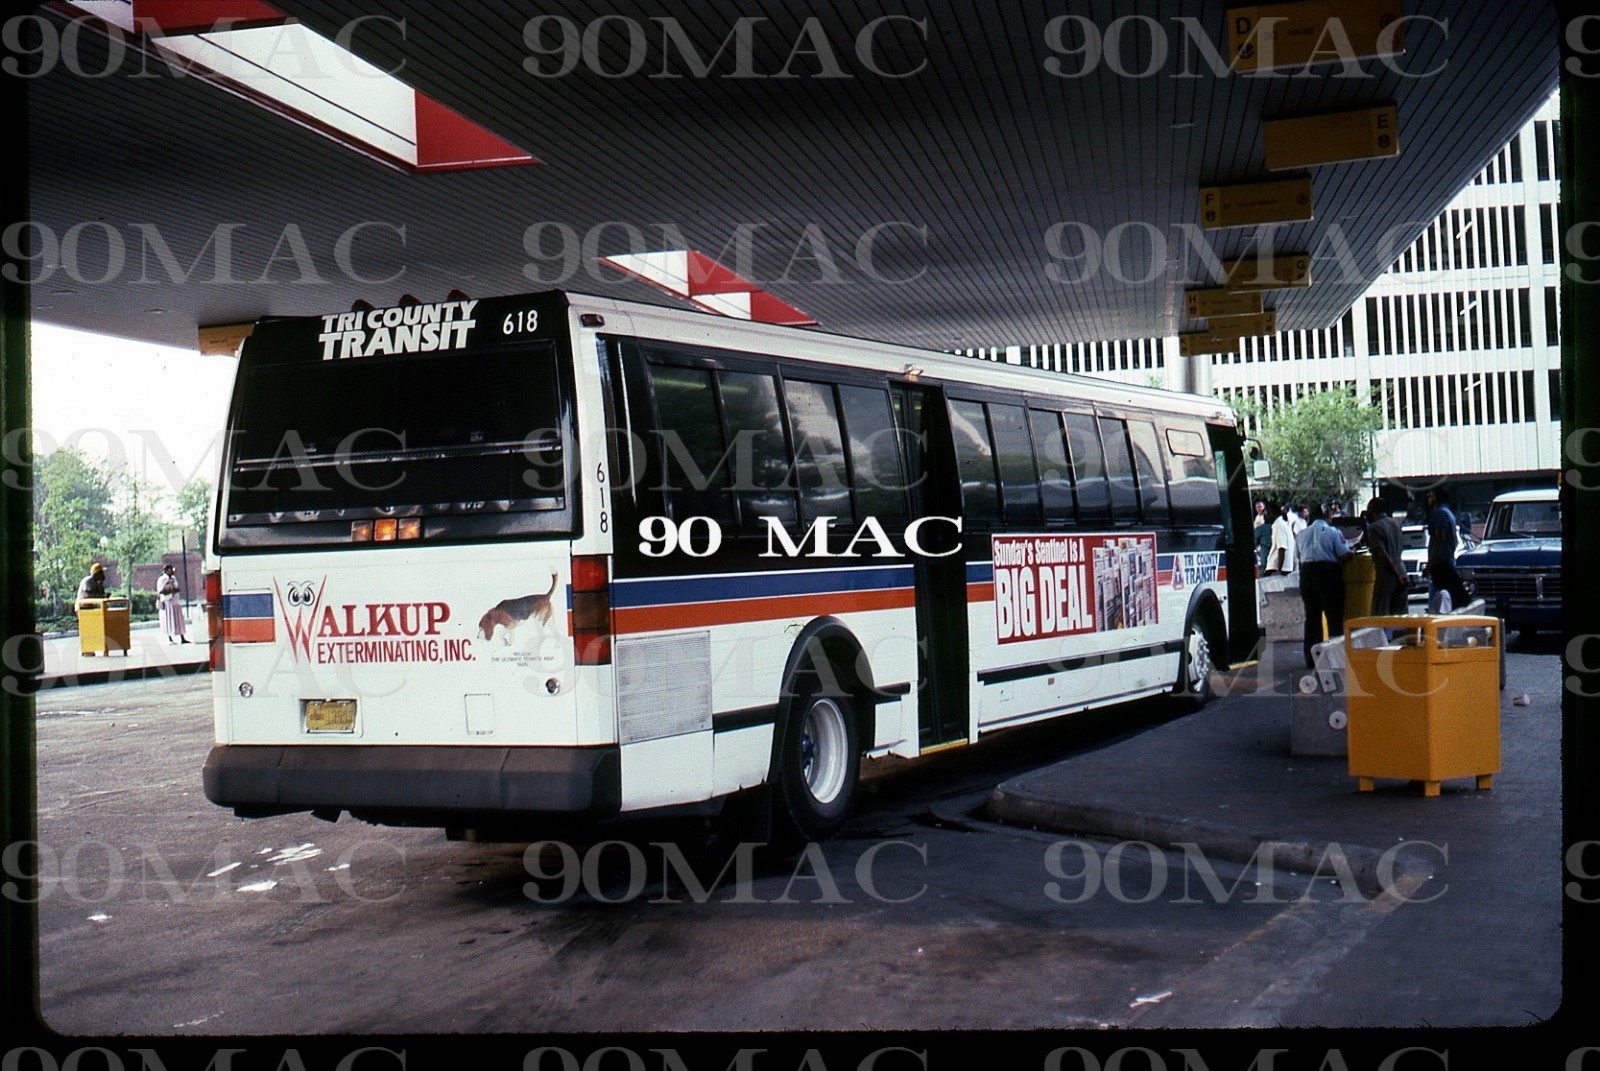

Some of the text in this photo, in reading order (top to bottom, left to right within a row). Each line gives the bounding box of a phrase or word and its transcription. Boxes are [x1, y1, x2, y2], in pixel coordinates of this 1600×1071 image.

[1236, 17, 1251, 35] D
[1377, 114, 1389, 129] E
[322, 299, 479, 334] TRI COUNTY
[502, 309, 539, 335] 618
[318, 319, 477, 361] TRANSIT
[994, 539, 1033, 567] Sunday's
[1035, 538, 1067, 564] Sentinel
[1079, 538, 1085, 562] A
[1184, 553, 1218, 567] TRI COUNTY
[1185, 566, 1216, 585] TRANSIT
[995, 565, 1093, 639] BIG DEAL
[273, 574, 451, 664] WALKUP
